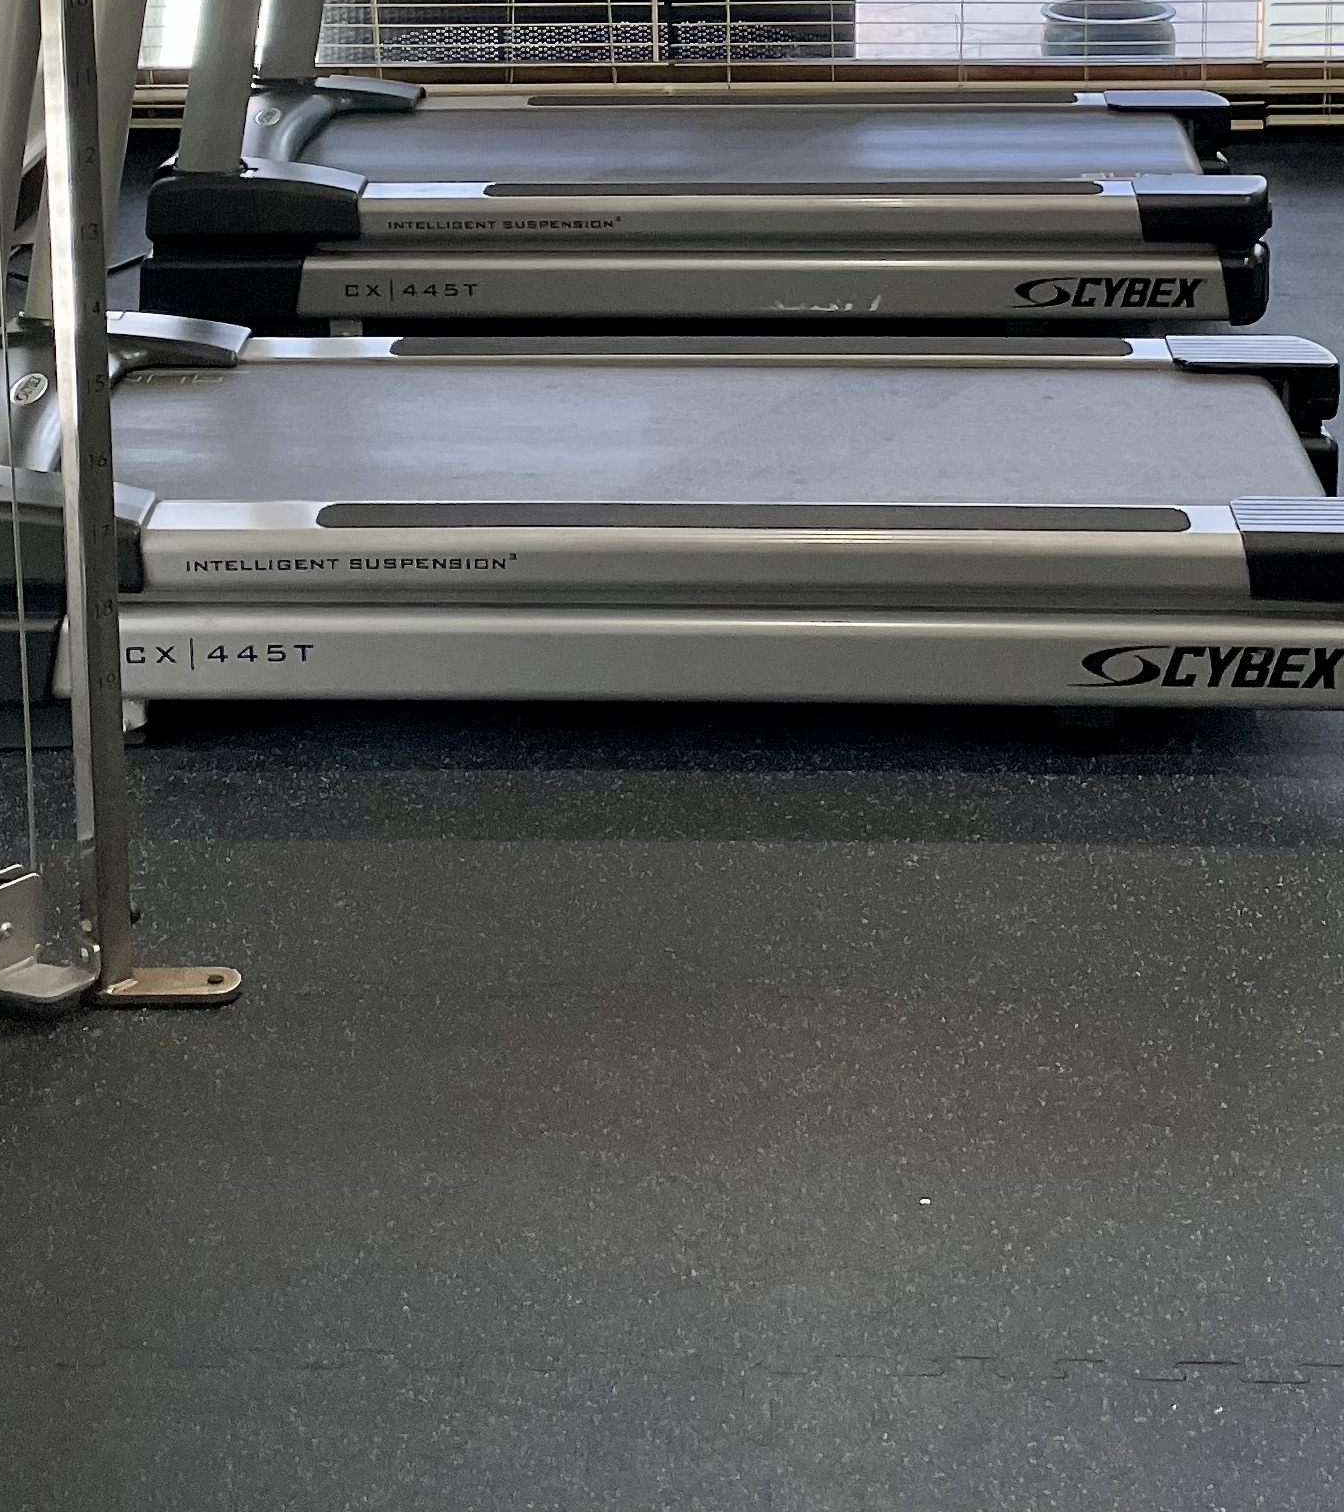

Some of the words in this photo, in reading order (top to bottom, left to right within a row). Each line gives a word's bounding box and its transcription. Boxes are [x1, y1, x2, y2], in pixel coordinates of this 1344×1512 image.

[387, 220, 497, 231] INTELLIGENT
[1070, 276, 1204, 308] CYBEX
[185, 557, 341, 573] INTELLIGENT
